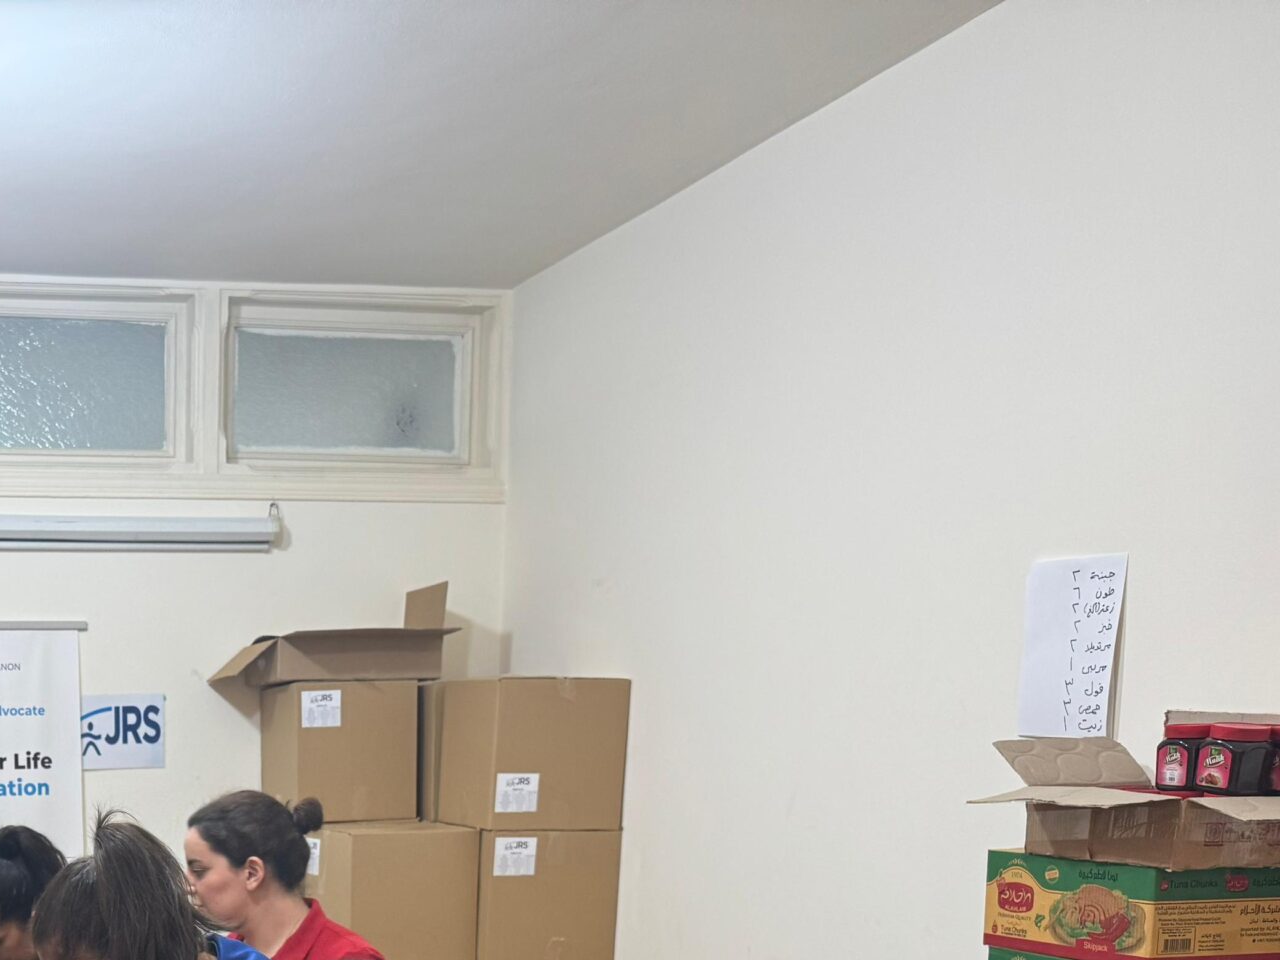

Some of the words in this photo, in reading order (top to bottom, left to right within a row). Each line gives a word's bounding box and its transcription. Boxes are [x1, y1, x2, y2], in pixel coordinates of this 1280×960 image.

[105, 705, 161, 745] JRS
[14, 751, 53, 770] Life
[1083, 941, 1108, 953] Skipjack
